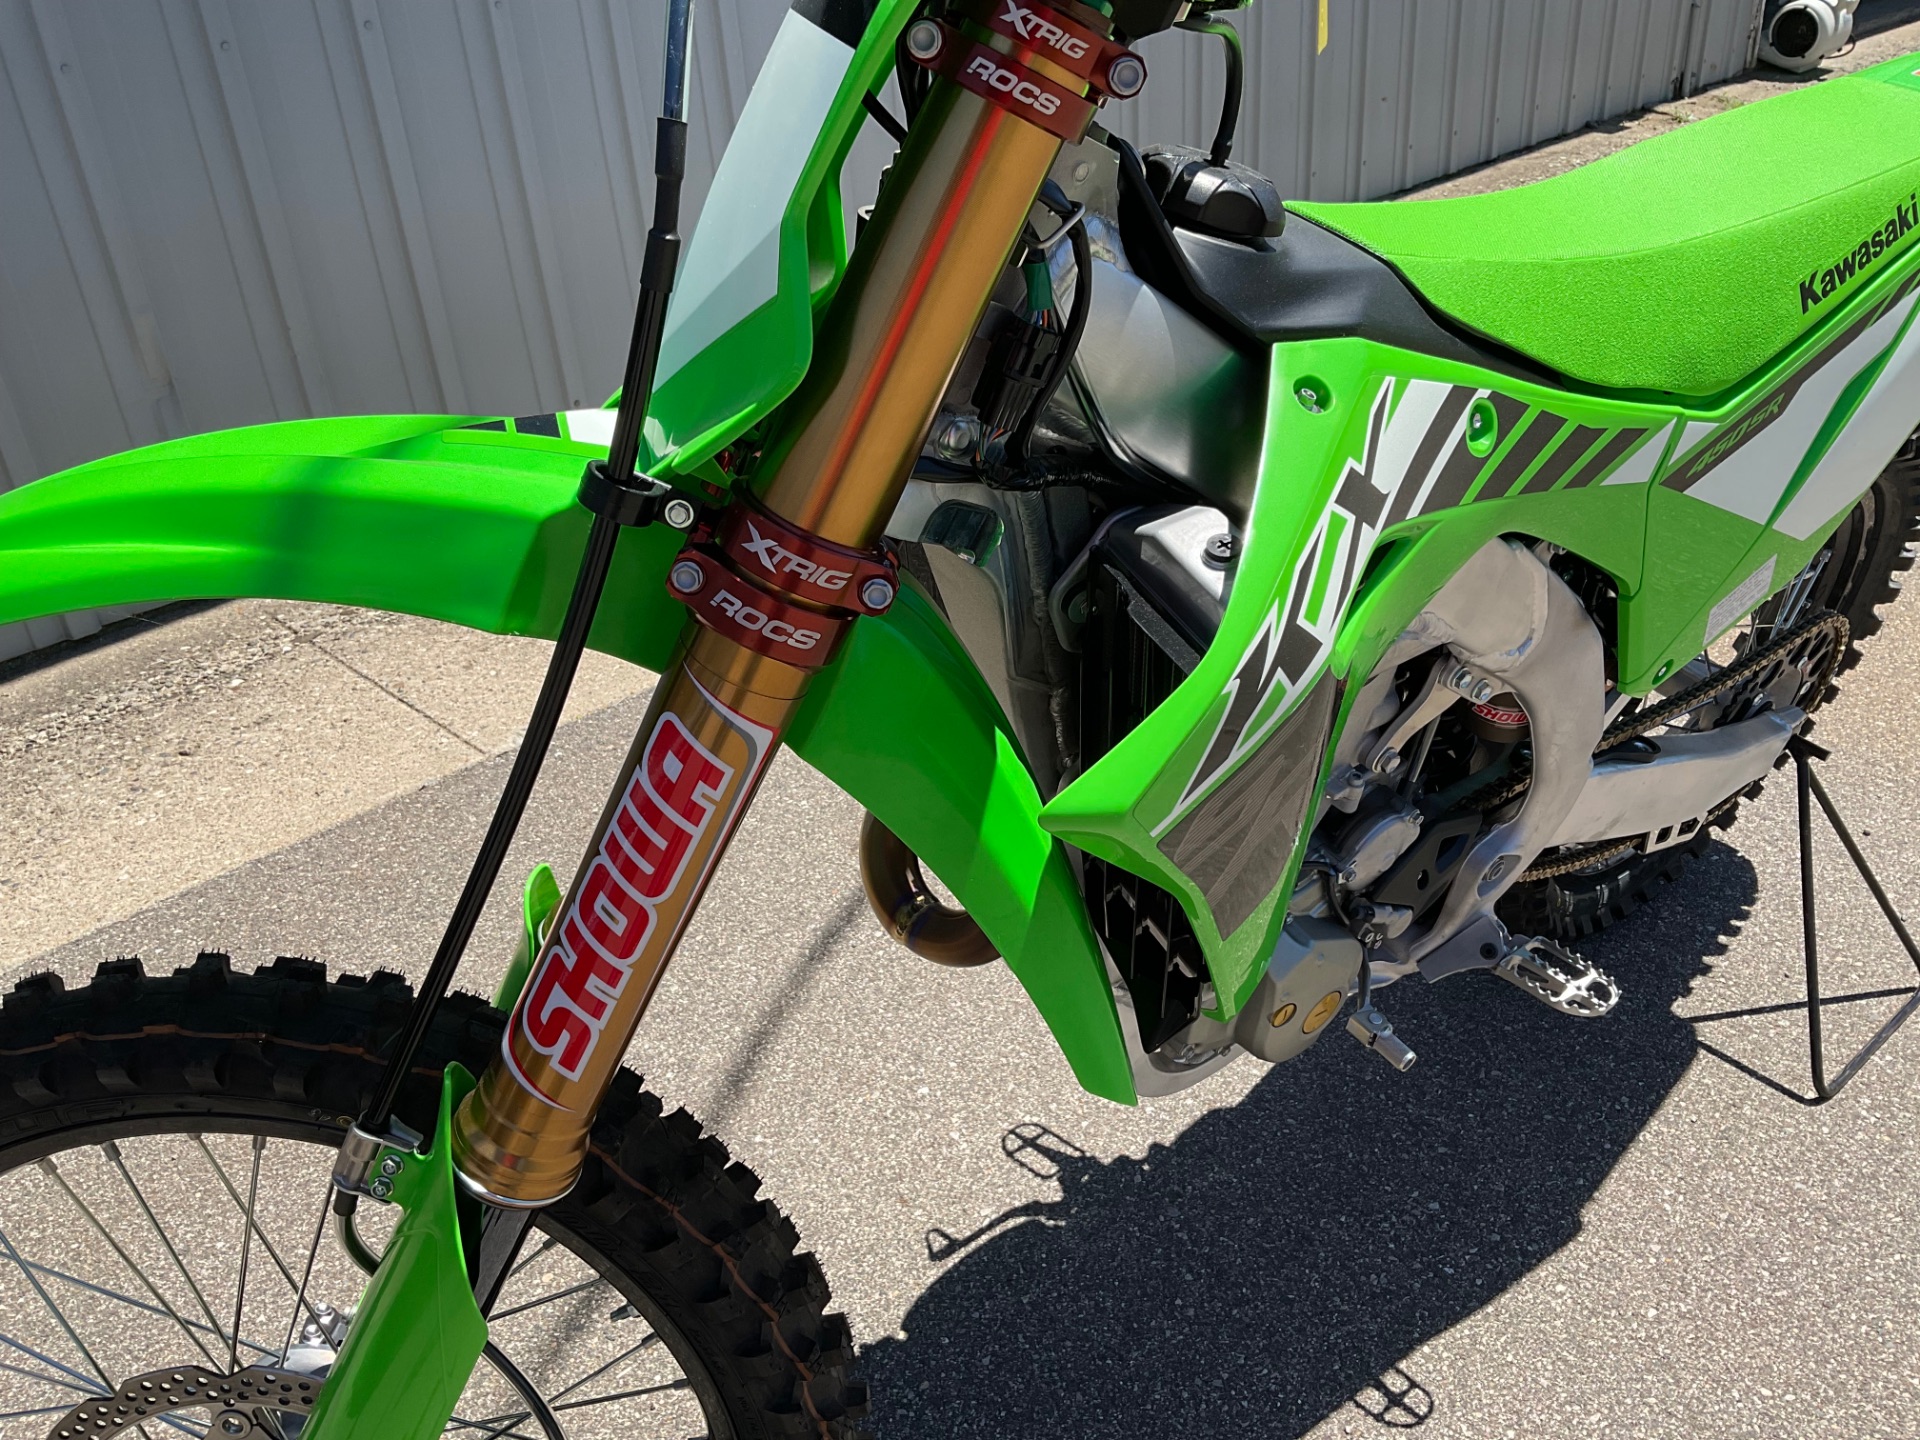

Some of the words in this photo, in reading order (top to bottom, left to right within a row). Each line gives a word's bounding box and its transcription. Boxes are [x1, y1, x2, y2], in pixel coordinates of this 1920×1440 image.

[999, 0, 1090, 59] XTRIG
[966, 56, 1061, 116] ROCS
[1800, 192, 1920, 315] Kawasaki
[741, 519, 853, 590] XTRIG
[709, 589, 821, 650] ROCS
[1472, 702, 1529, 724] SHOW
[523, 711, 735, 1082] SHOWA
